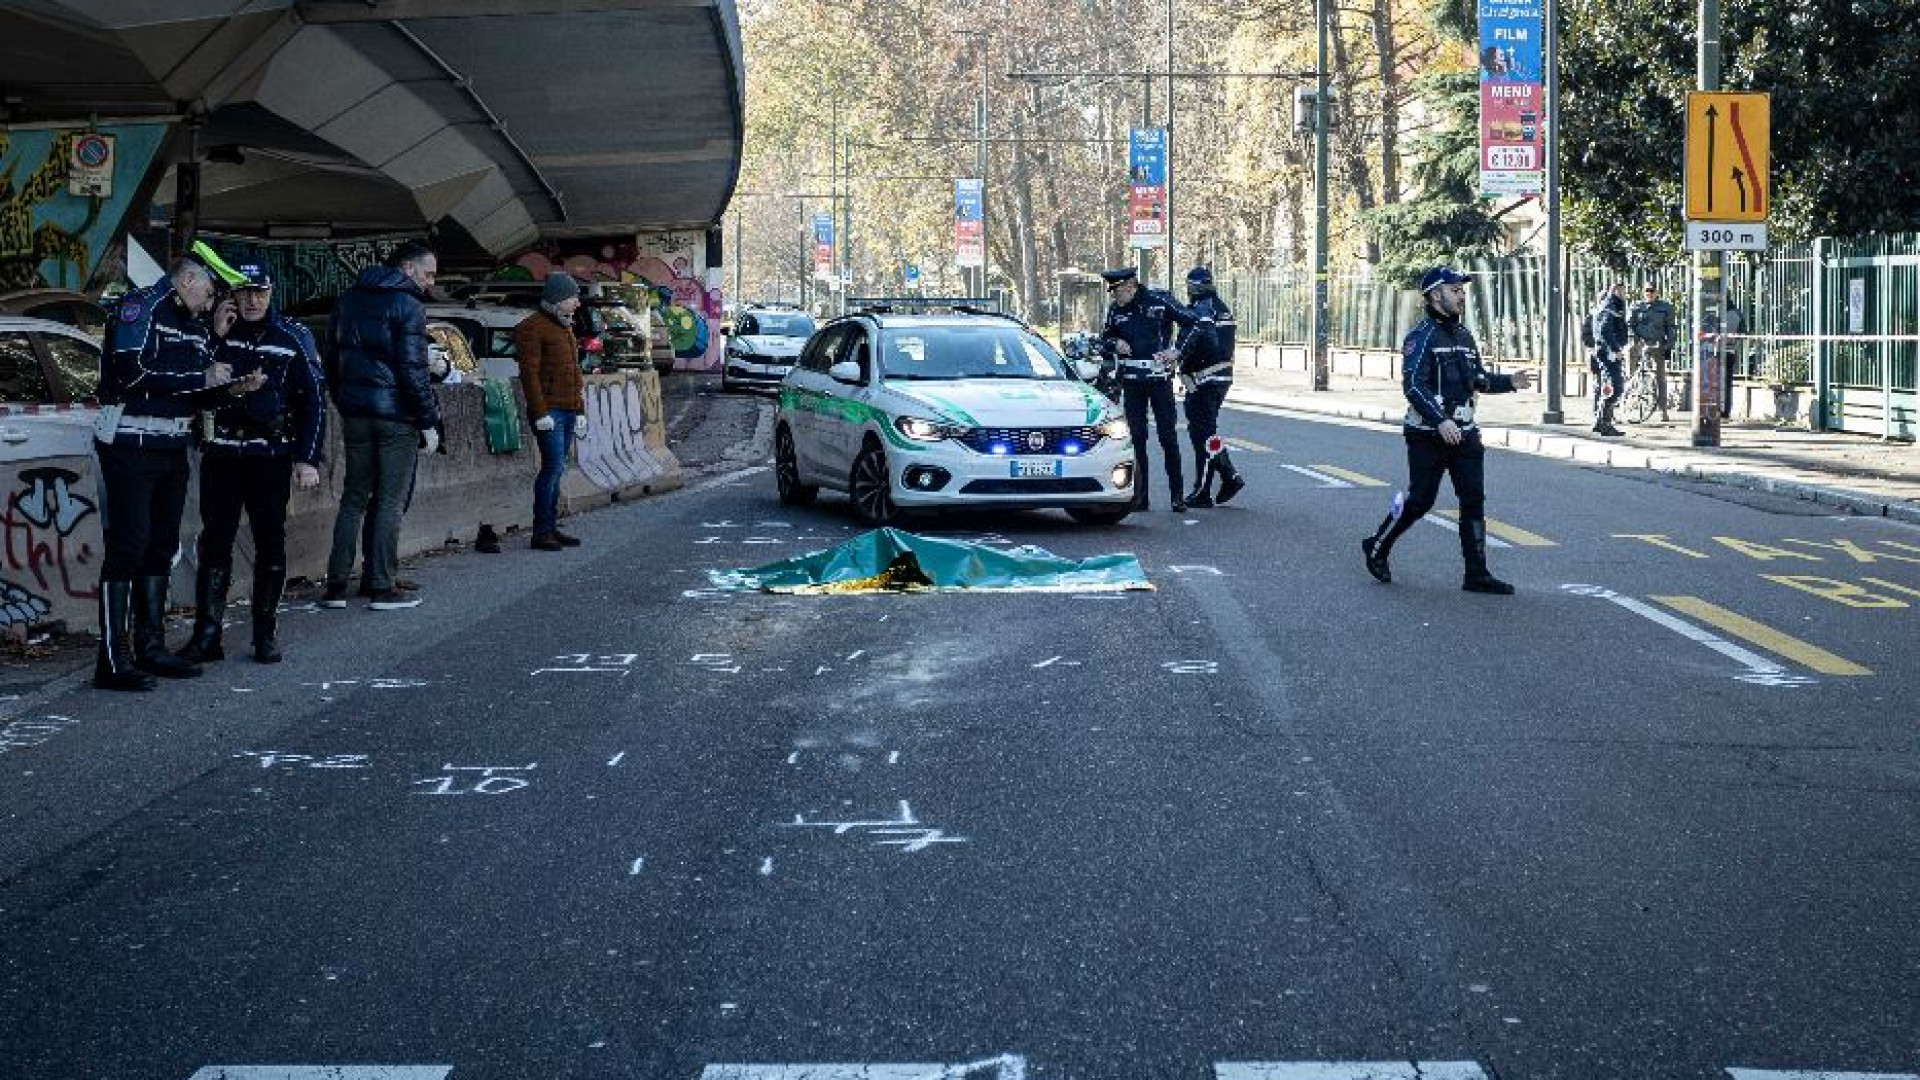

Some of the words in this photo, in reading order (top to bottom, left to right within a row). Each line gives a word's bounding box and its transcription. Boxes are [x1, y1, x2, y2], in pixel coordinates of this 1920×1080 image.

[1495, 28, 1528, 41] FILM
[1701, 229, 1734, 244] 300
[1740, 233, 1754, 244] m
